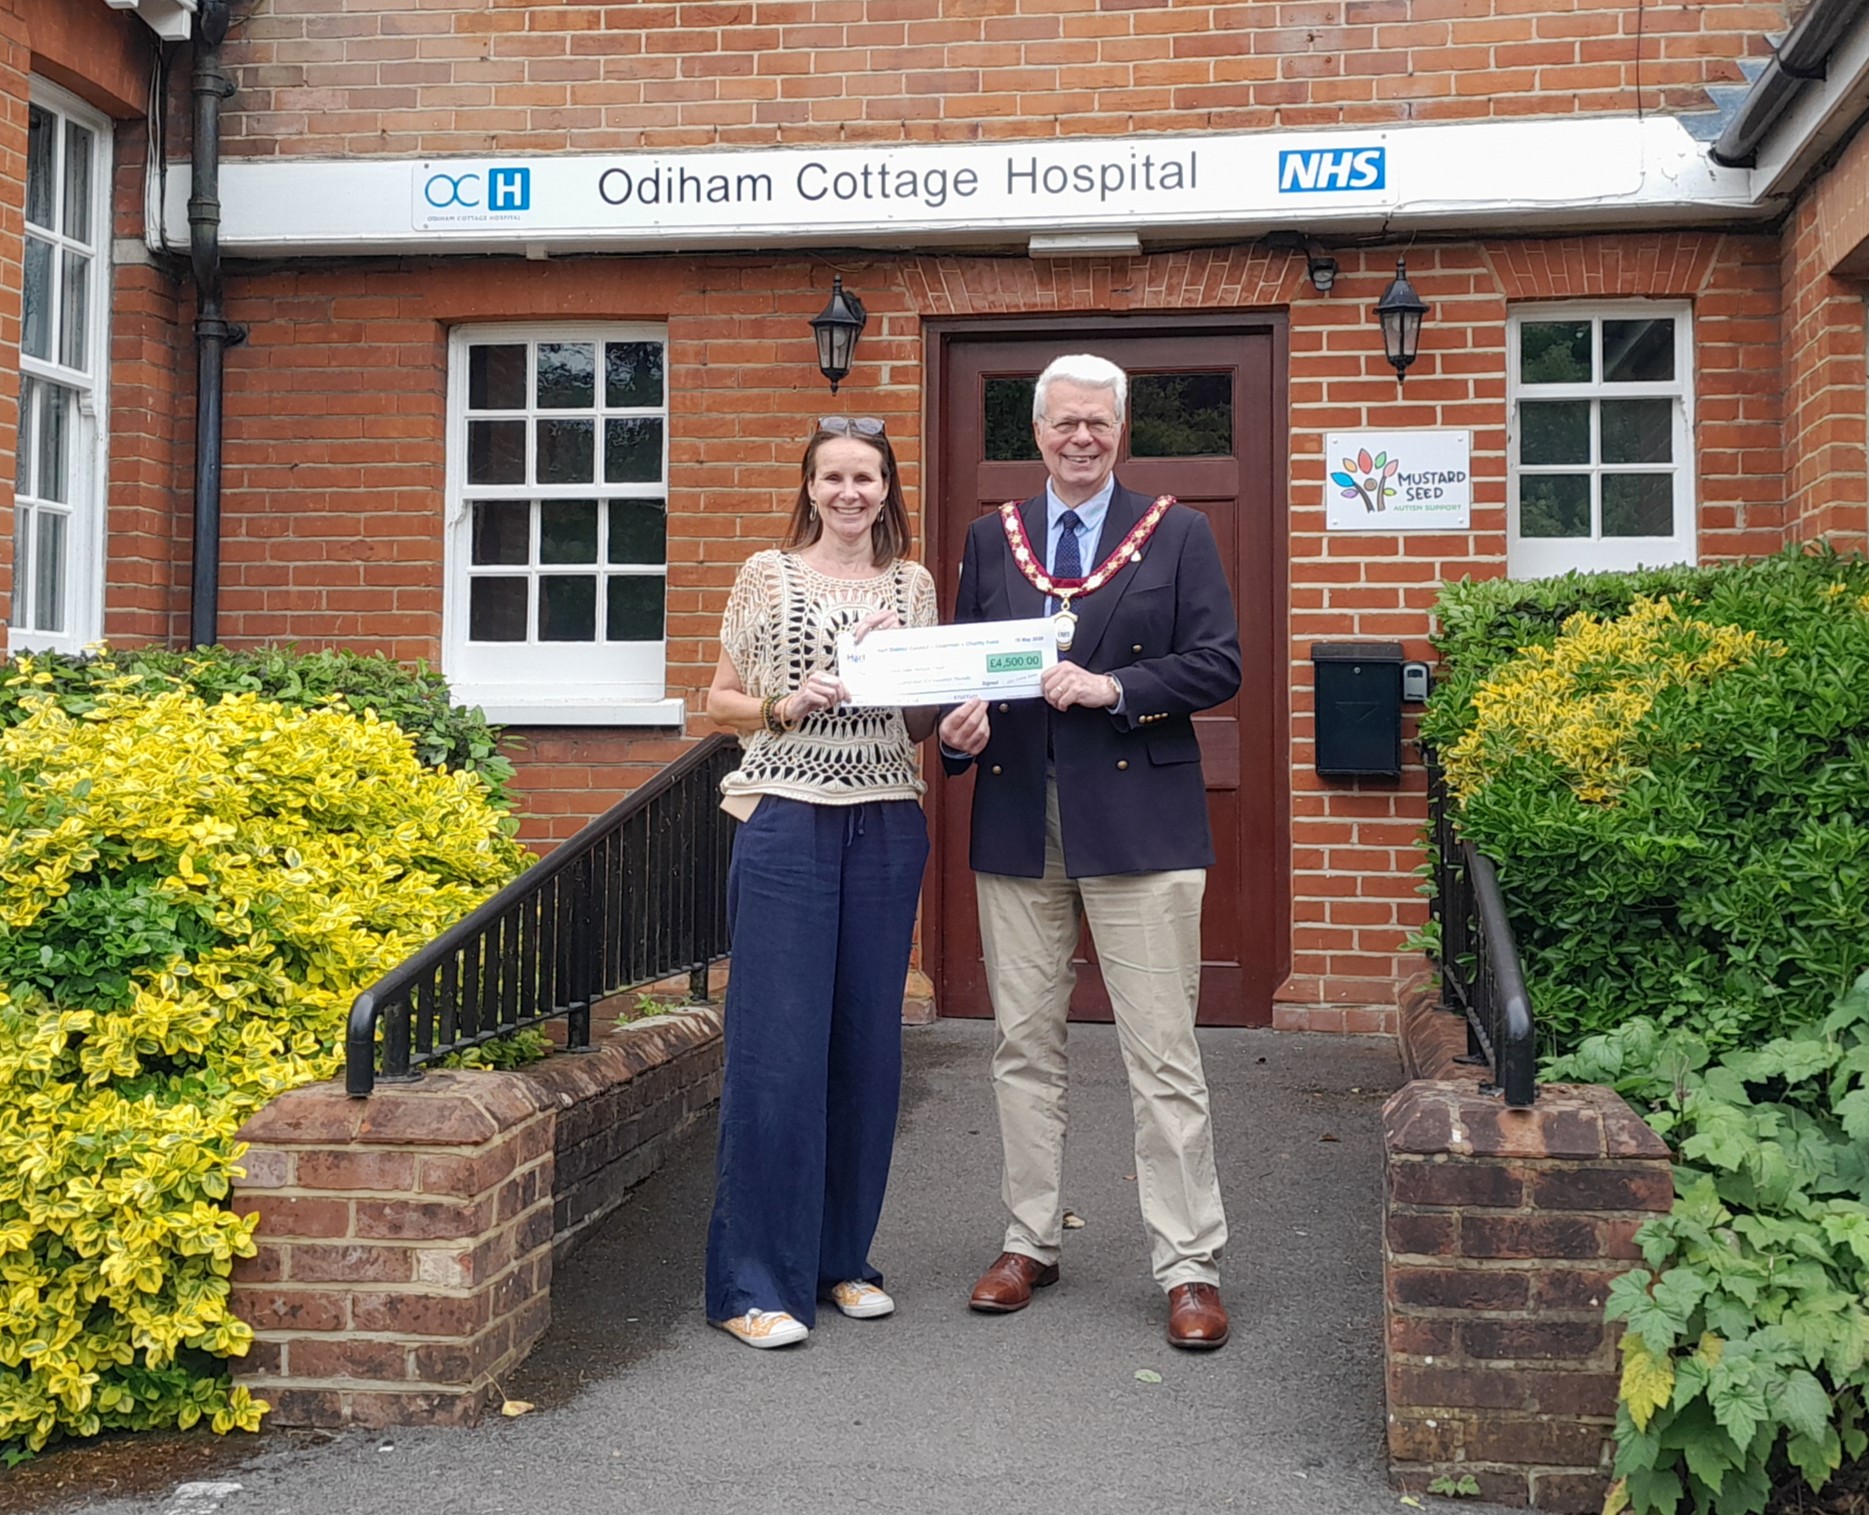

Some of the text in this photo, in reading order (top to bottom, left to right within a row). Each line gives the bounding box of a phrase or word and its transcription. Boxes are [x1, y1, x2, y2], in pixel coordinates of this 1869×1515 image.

[1282, 149, 1382, 189] NHS
[599, 150, 1197, 207] Odiham Cottage Hospital
[1397, 470, 1467, 487] MUSTARD
[1406, 487, 1443, 502] SEED
[1393, 504, 1462, 512] AUTISM SUPPORT
[989, 655, 1040, 669] £4,500.00
